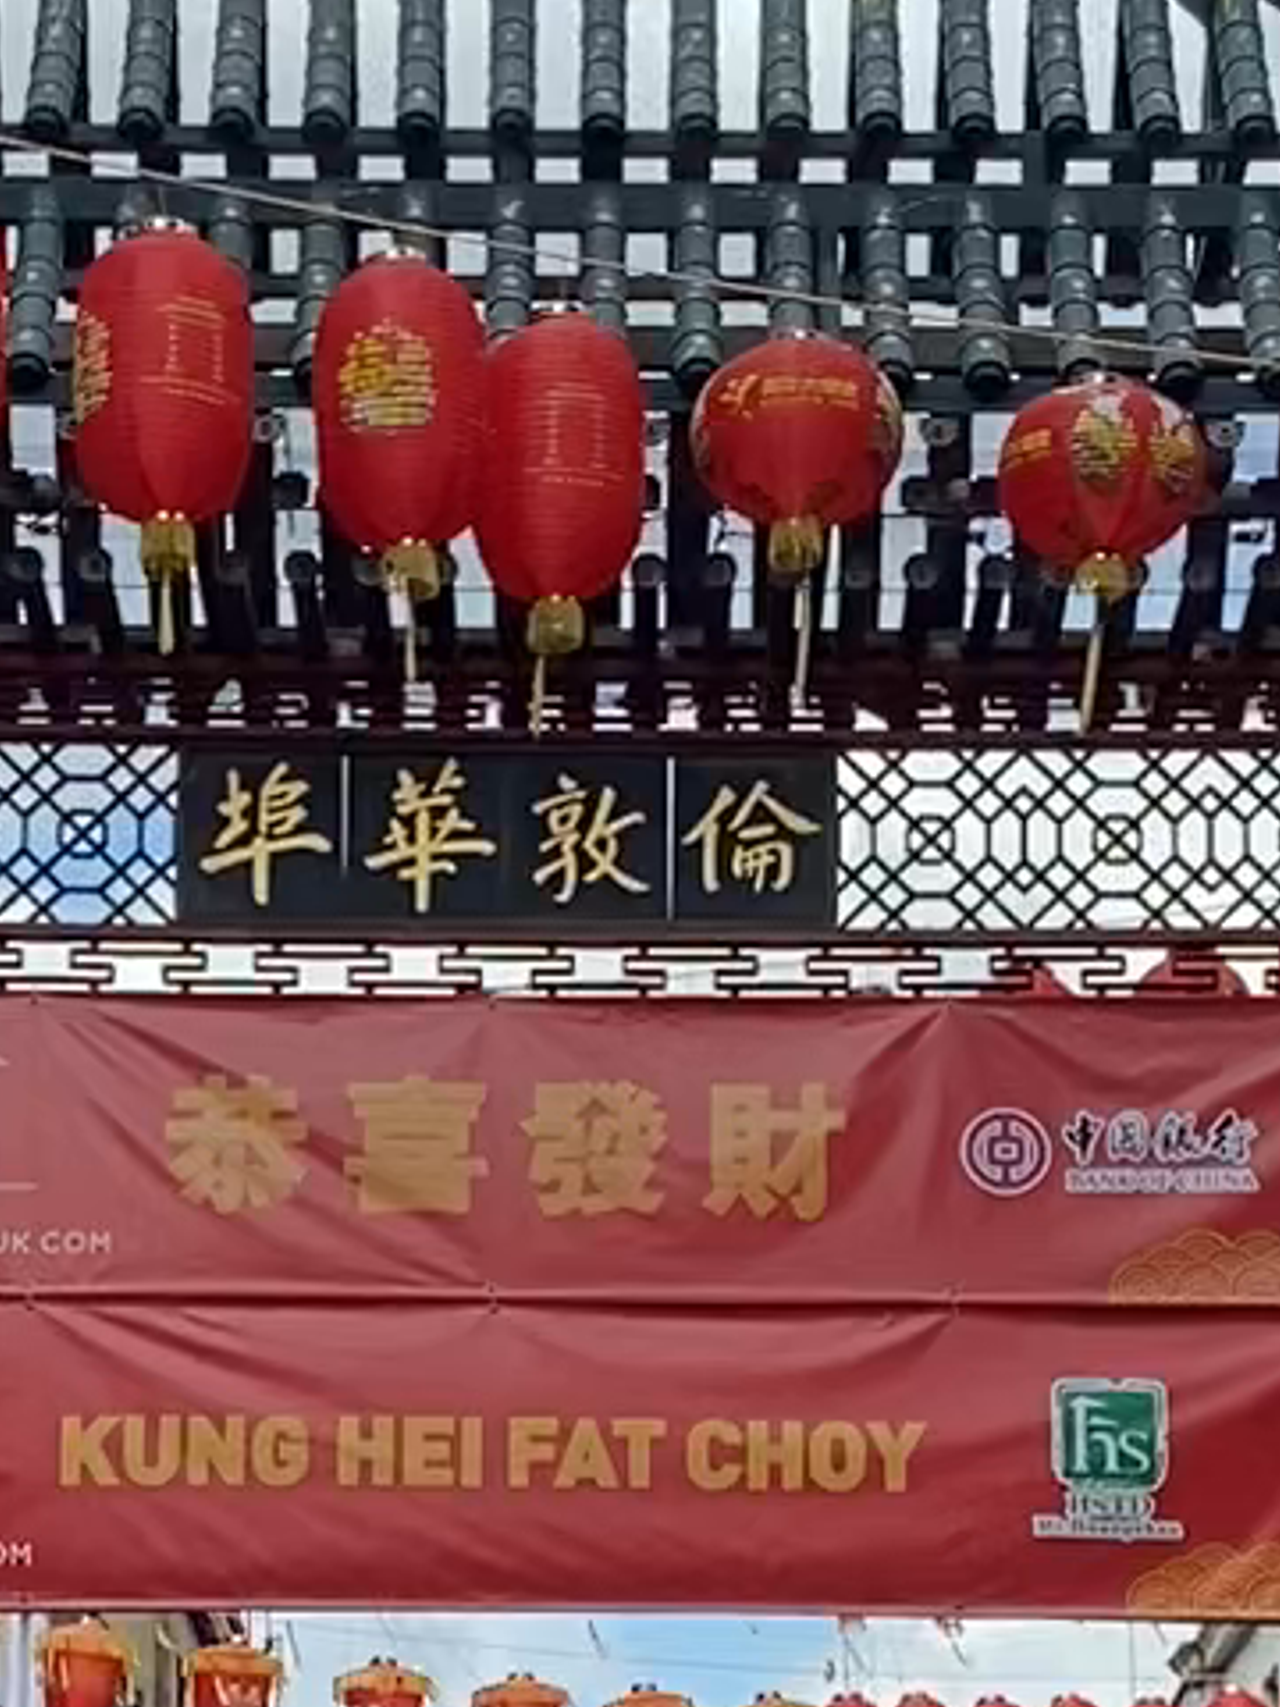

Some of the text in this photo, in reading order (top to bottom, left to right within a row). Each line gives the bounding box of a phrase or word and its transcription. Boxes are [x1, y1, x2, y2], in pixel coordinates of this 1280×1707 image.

[165, 1075, 846, 1220] 恭喜發財
[59, 1414, 927, 1492] KUNG HEI FAT CHOY
